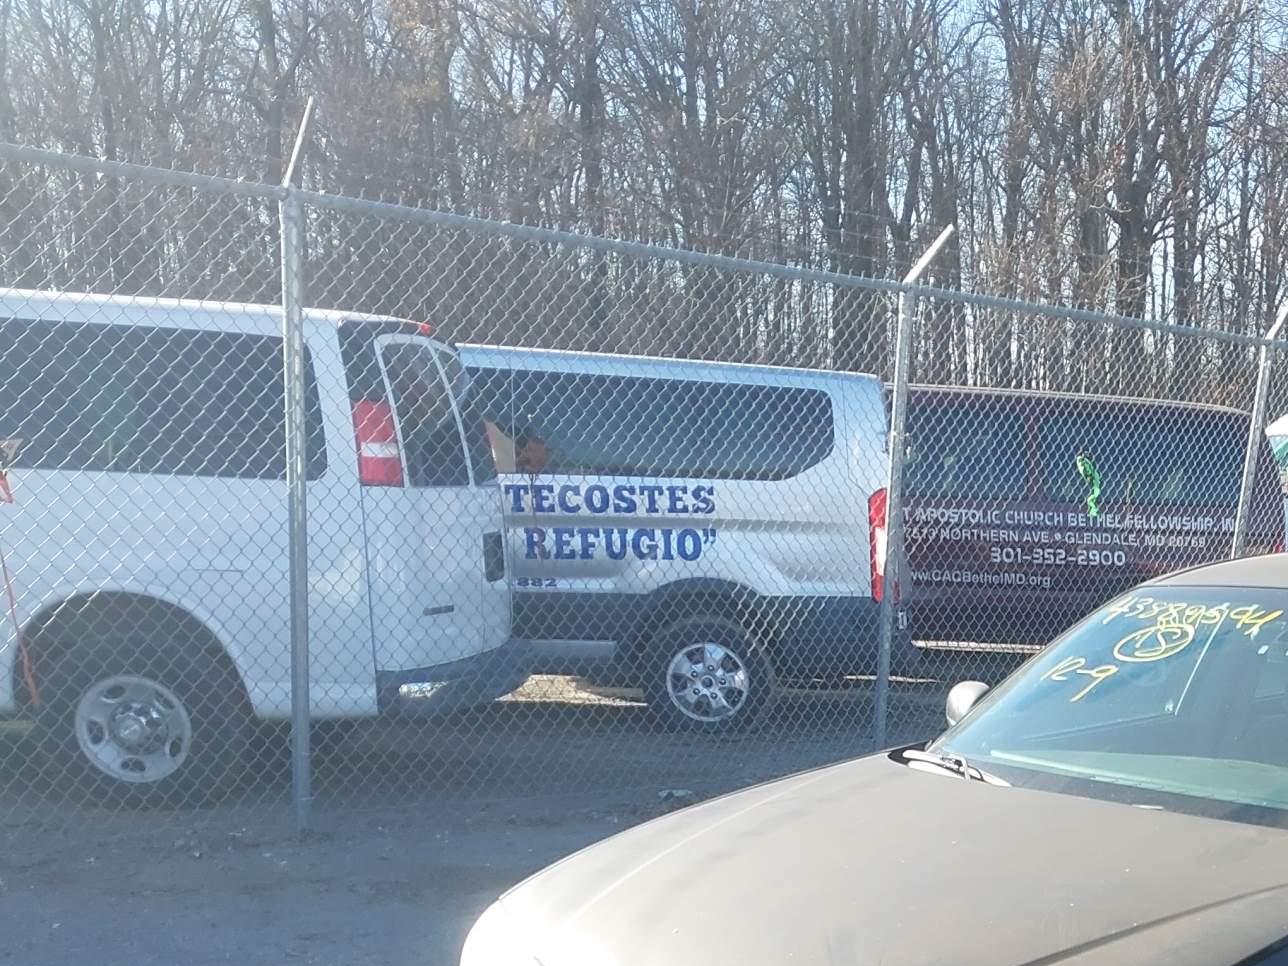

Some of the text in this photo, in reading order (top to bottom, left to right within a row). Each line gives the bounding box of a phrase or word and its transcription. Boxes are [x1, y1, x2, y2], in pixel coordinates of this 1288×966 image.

[504, 484, 715, 514] TECOSTES
[916, 508, 1001, 524] APOSTOLIC
[1005, 511, 1063, 526] CHURCH
[1067, 513, 1122, 528] BETHEL
[941, 528, 1019, 543] NORTHERN
[1145, 535, 1166, 547] MD
[991, 546, 1126, 566] 301-352-2900
